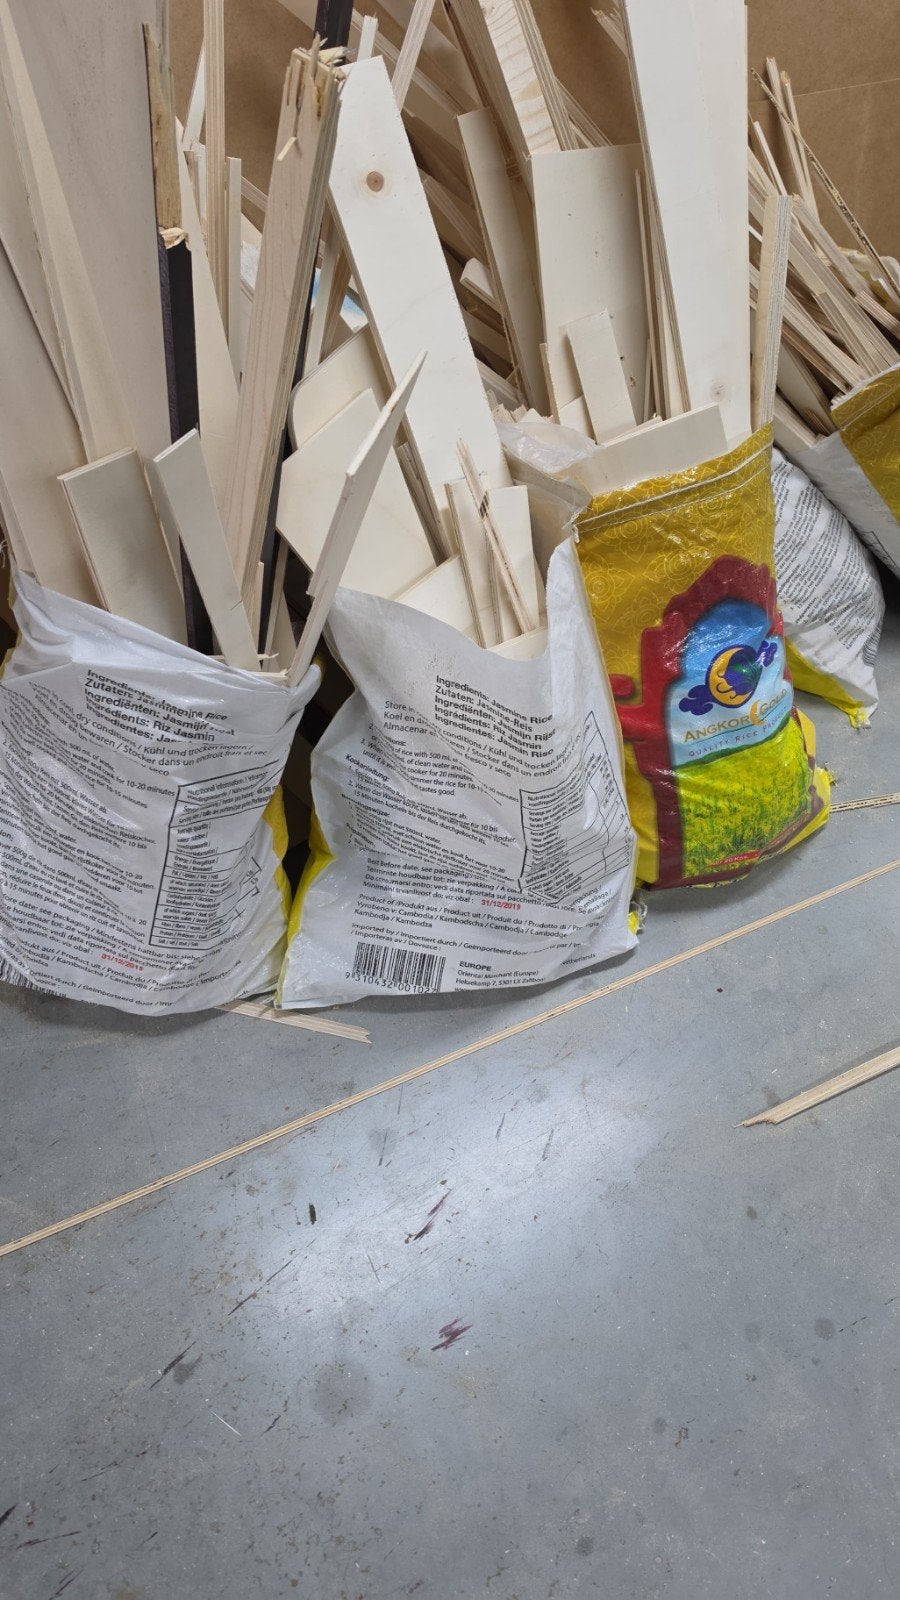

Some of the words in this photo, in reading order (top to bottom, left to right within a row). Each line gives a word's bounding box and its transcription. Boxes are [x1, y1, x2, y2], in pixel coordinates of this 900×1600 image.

[85, 678, 133, 699] Zutaten:
[85, 688, 160, 718] Ingrediënten:
[436, 675, 490, 702] Ingredients:
[492, 700, 528, 721] Jasmine
[530, 714, 553, 724] Rice
[436, 685, 474, 705] Zutaten:
[477, 699, 533, 733] Jasmine-Reis
[86, 696, 150, 727] Ingrédients:
[153, 721, 171, 732] Riz
[174, 728, 215, 742] Jasmin
[86, 703, 154, 740] Ingredientes:
[206, 712, 228, 721] Rice
[435, 695, 496, 723] Ingrediënten:
[498, 719, 532, 741] Jasmijn
[684, 715, 751, 743] ANGKOR
[760, 688, 788, 716] GOLD
[76, 713, 91, 725] dry
[92, 721, 137, 748] conditions
[144, 746, 165, 755] Kühl
[168, 748, 187, 757] und
[385, 701, 407, 711] Store
[443, 730, 483, 750] conditions
[488, 746, 507, 758] Kühl
[509, 755, 523, 766] und
[524, 759, 556, 771] trocken
[435, 705, 491, 729] Ingrédients:
[493, 725, 506, 737] Riz
[508, 735, 542, 750] Jasmin
[435, 714, 495, 741] Ingredientes:
[498, 736, 529, 756] Jasmin
[531, 748, 554, 758] Riso
[80, 725, 115, 748] bewaren
[122, 745, 156, 765] Stocker
[158, 755, 181, 766] dans
[196, 752, 223, 764] endroit
[383, 722, 428, 735] Almacenar
[465, 754, 488, 767] fresco
[495, 767, 512, 778] seco
[384, 711, 403, 721] Koel
[472, 748, 501, 765] Stocker
[502, 760, 520, 773] dans
[521, 770, 532, 778] un
[688, 739, 730, 757] QUALITY
[735, 731, 759, 743] RICE
[414, 751, 428, 759] with
[414, 760, 431, 768] clean
[432, 762, 450, 770] water
[407, 768, 428, 776] cooker
[429, 769, 439, 777] for
[439, 770, 447, 778] 20
[433, 778, 445, 786] the
[445, 780, 457, 788] rice
[457, 781, 467, 789] for
[126, 780, 146, 790] 10-20
[146, 786, 176, 797] minutes
[382, 792, 402, 804] Wasser
[419, 785, 437, 794] tastes
[122, 794, 148, 809] minutes
[481, 824, 489, 832] 10
[13, 845, 28, 859] 500g
[16, 868, 29, 876] une
[24, 862, 40, 872] d'eau
[380, 860, 401, 870] Before
[402, 863, 420, 871] date:
[434, 868, 470, 880] packaging
[39, 884, 53, 894] feux
[398, 872, 433, 881] houdbaar
[457, 880, 495, 892] verpakking
[412, 882, 434, 890] entro:
[449, 886, 464, 894] data
[465, 888, 496, 899] riportata
[10, 882, 18, 890] 15
[18, 886, 44, 900] minutes
[97, 918, 109, 928] cuit
[359, 894, 386, 905] Product
[443, 908, 472, 918] Product
[487, 914, 512, 924] Produit
[528, 921, 559, 930] Prodotto
[12, 907, 50, 925] houdbaar
[65, 925, 77, 933] zie
[77, 930, 117, 950] verpakking
[18, 900, 39, 911] date:
[40, 908, 53, 916] see
[53, 912, 94, 932] packaging
[96, 928, 137, 950] Mindestens
[354, 908, 391, 921] Kambodja
[395, 917, 433, 929] Kambodza
[357, 901, 390, 913] Vyrobeno
[398, 910, 434, 920] Cambodia
[439, 916, 485, 928] Kambodscha
[490, 923, 525, 934] Cambodja
[530, 929, 569, 939] Cambodge
[50, 930, 66, 939] vedi
[68, 934, 85, 944] data
[86, 941, 117, 956] riportata
[352, 923, 385, 933] Imported
[386, 928, 395, 936] by
[400, 931, 437, 944] Importiert
[437, 938, 458, 947] durch
[354, 930, 393, 943] Importeras
[74, 944, 91, 954] obal
[42, 946, 56, 954] aus
[61, 952, 91, 968] Product
[107, 968, 133, 983] Produit
[457, 969, 484, 979] Oriental
[513, 970, 539, 978] (Europe)
[459, 960, 492, 972] EUROPE
[345, 971, 351, 980] 9
[355, 974, 393, 989] 310432
[456, 978, 492, 987] Heksekamp
